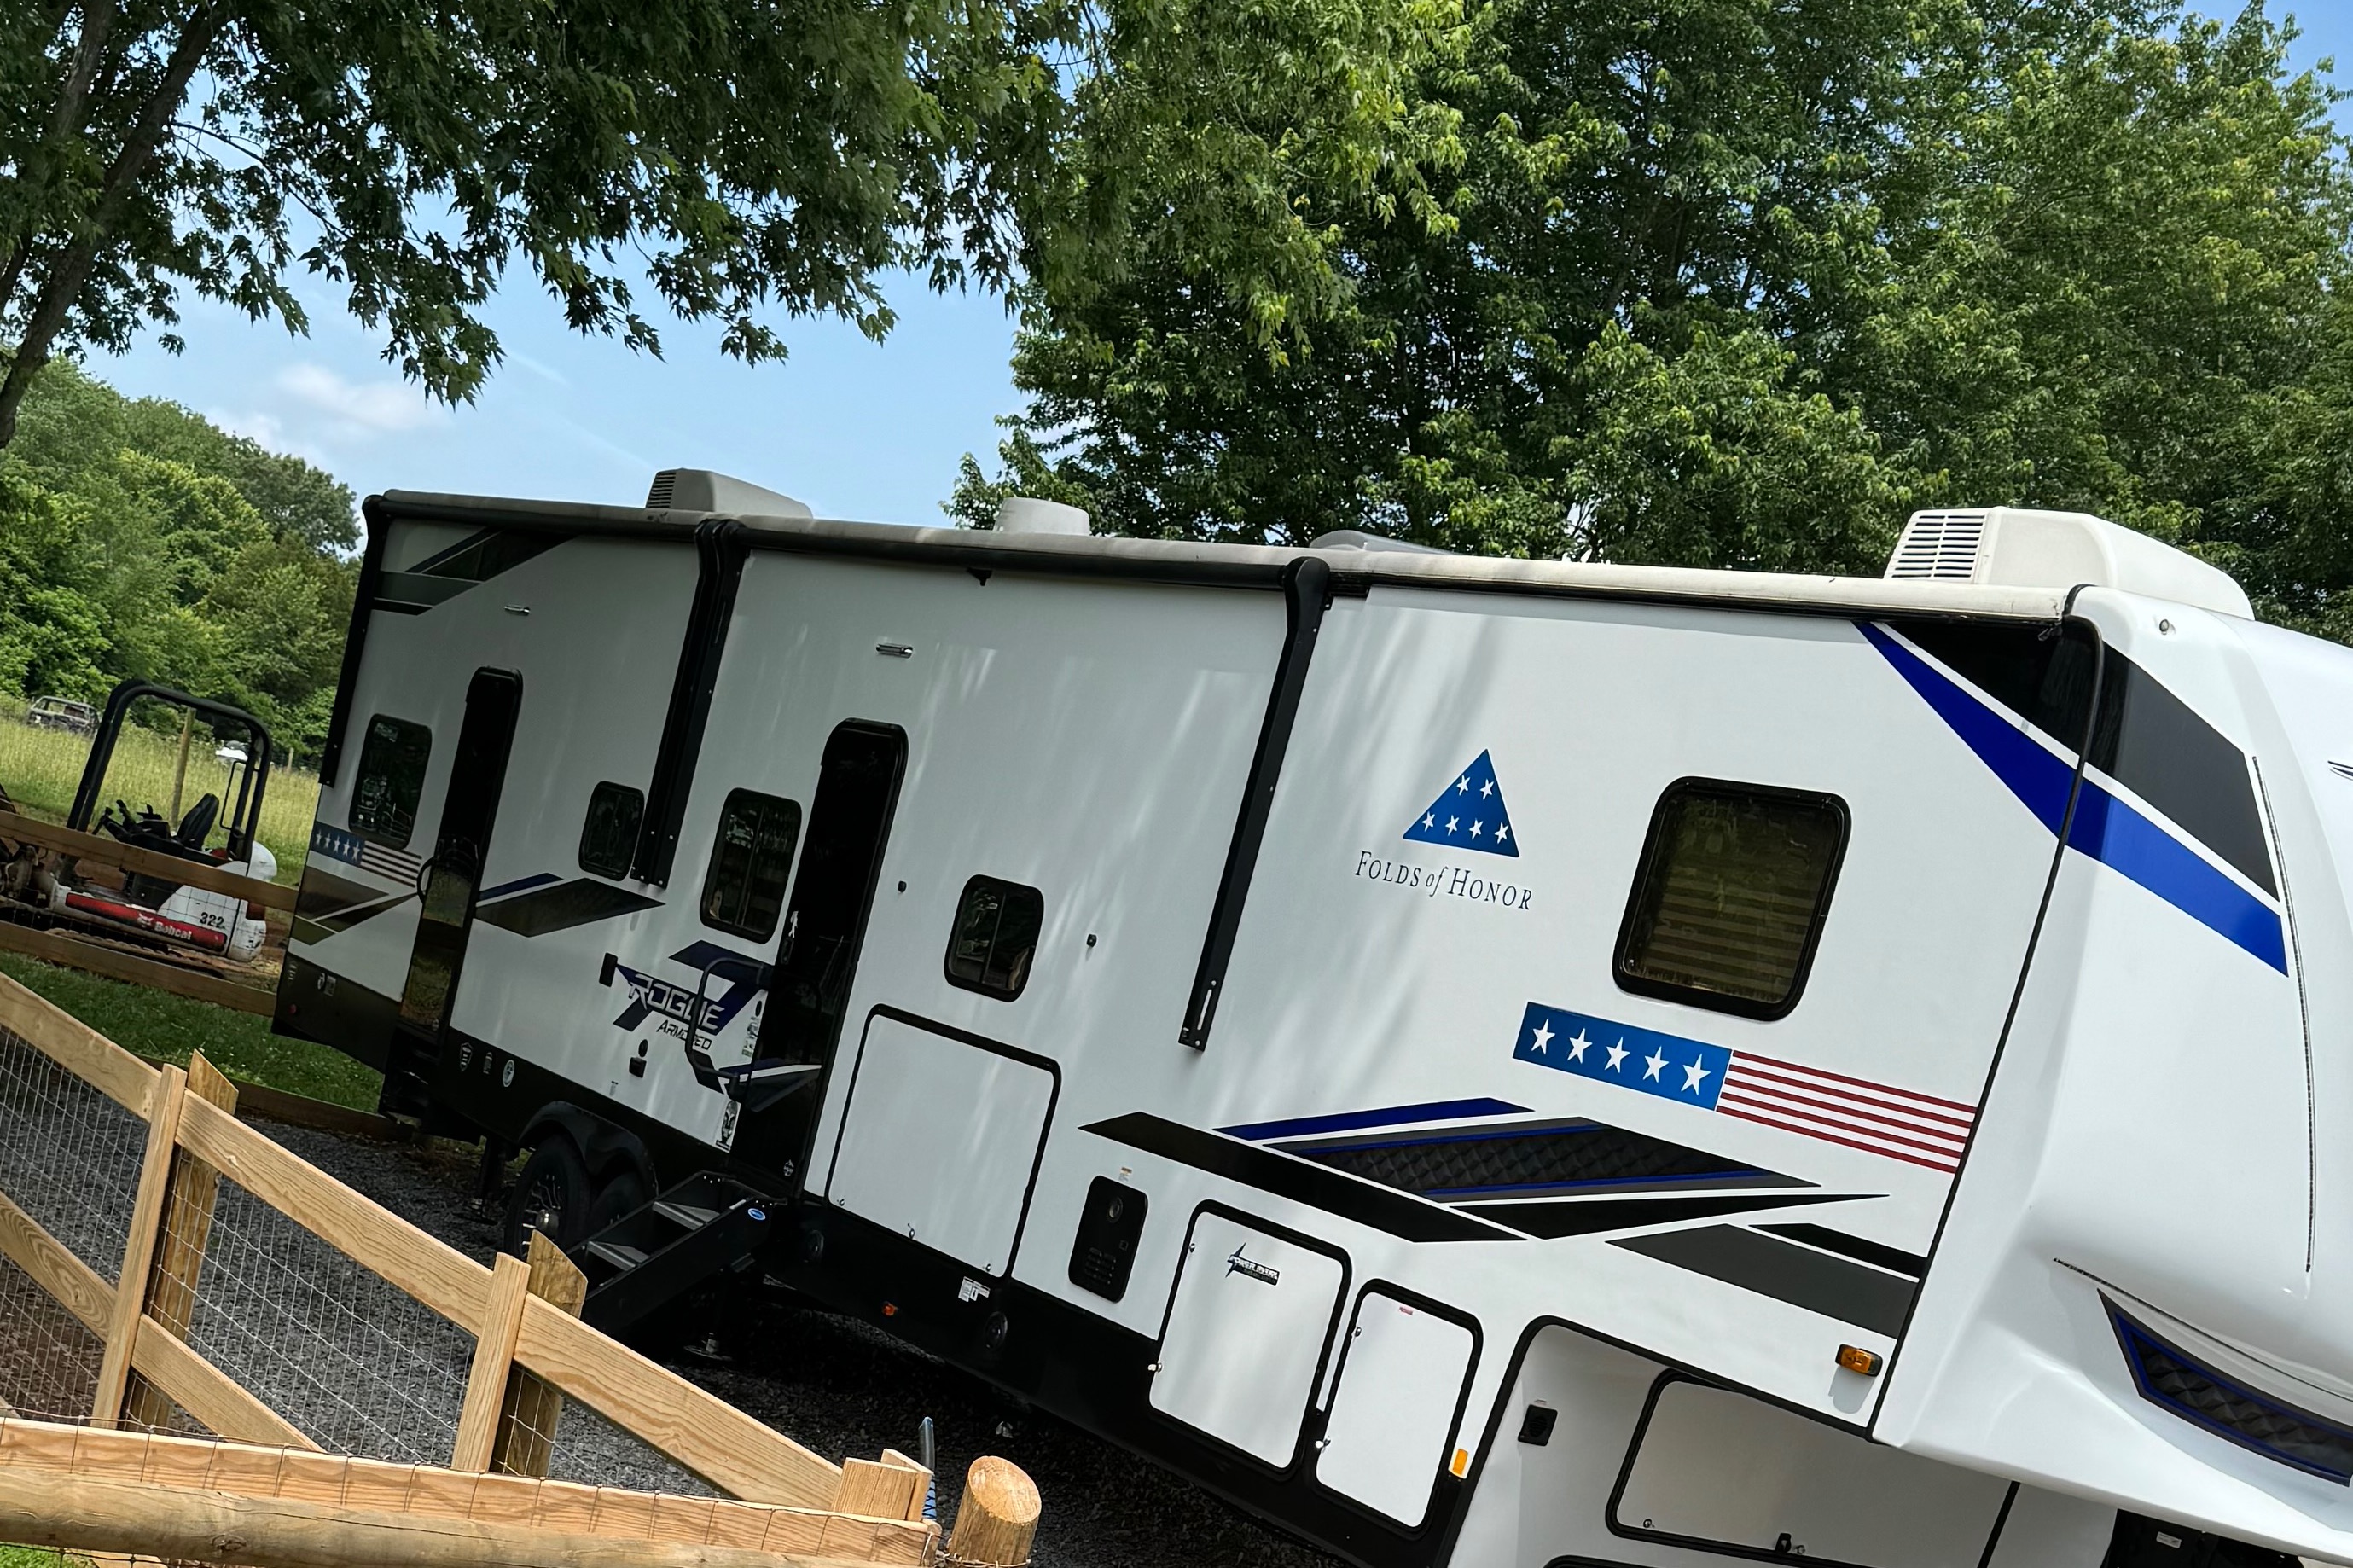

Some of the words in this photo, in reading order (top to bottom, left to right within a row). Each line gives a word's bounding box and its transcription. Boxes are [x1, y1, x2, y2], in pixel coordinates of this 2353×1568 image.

[1355, 851, 1421, 887] FOLDS
[1426, 866, 1449, 897] of
[1447, 868, 1532, 910] HONOR
[199, 911, 226, 930] 322
[154, 922, 192, 940] Bobcat
